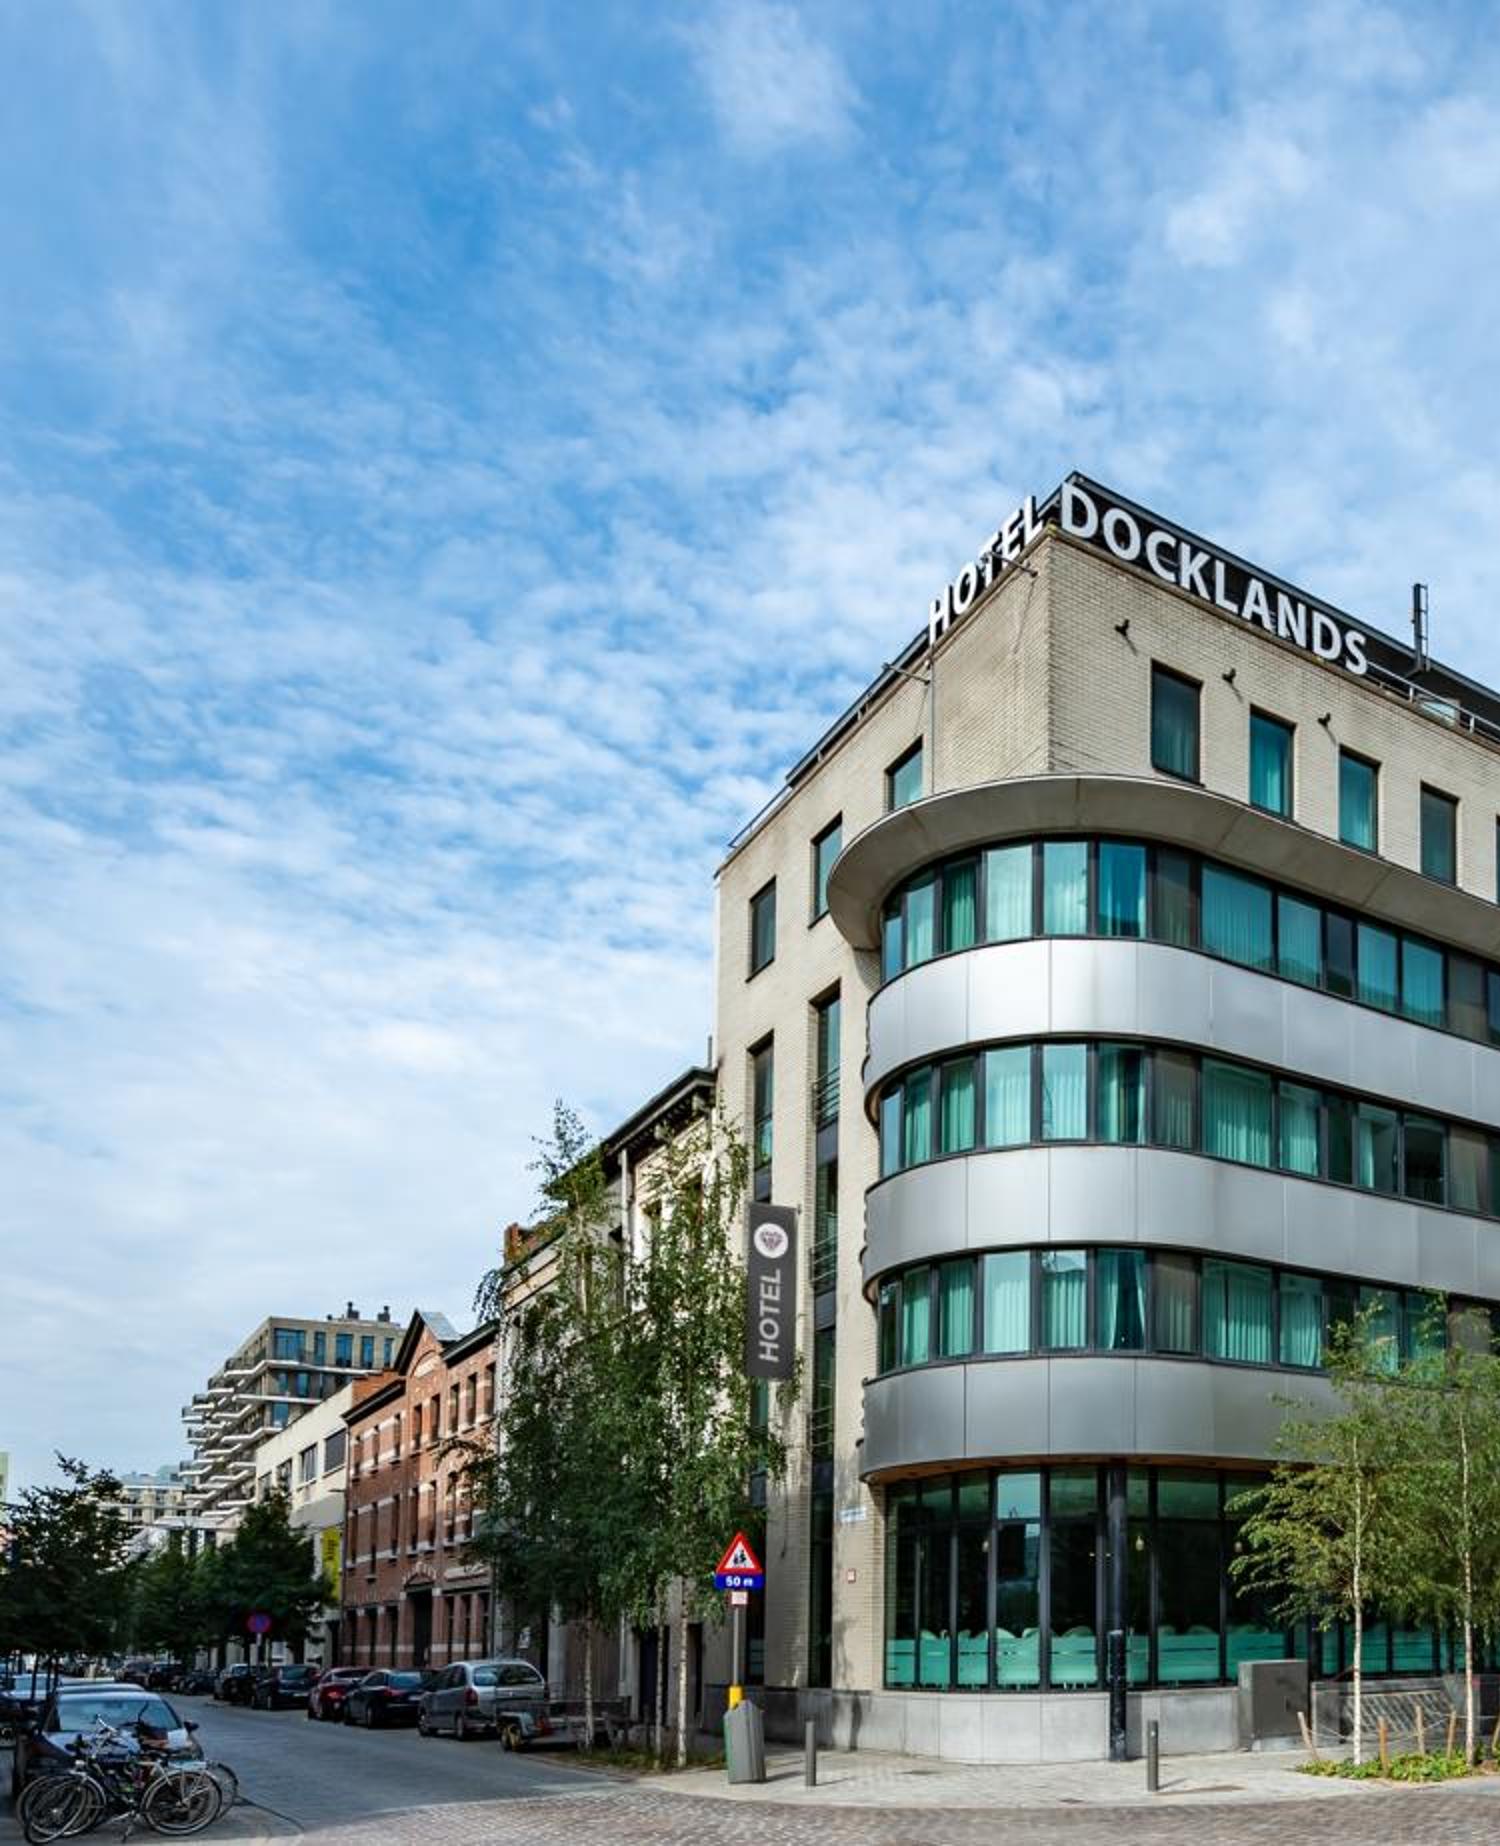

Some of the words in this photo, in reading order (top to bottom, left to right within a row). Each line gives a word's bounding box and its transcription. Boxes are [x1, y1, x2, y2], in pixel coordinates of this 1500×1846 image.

[928, 496, 1043, 646] HOTEL
[1060, 480, 1367, 675] DOCKLANDS
[758, 1268, 781, 1363] HOTEL
[725, 1575, 741, 1587] 50
[743, 1577, 753, 1587] m
